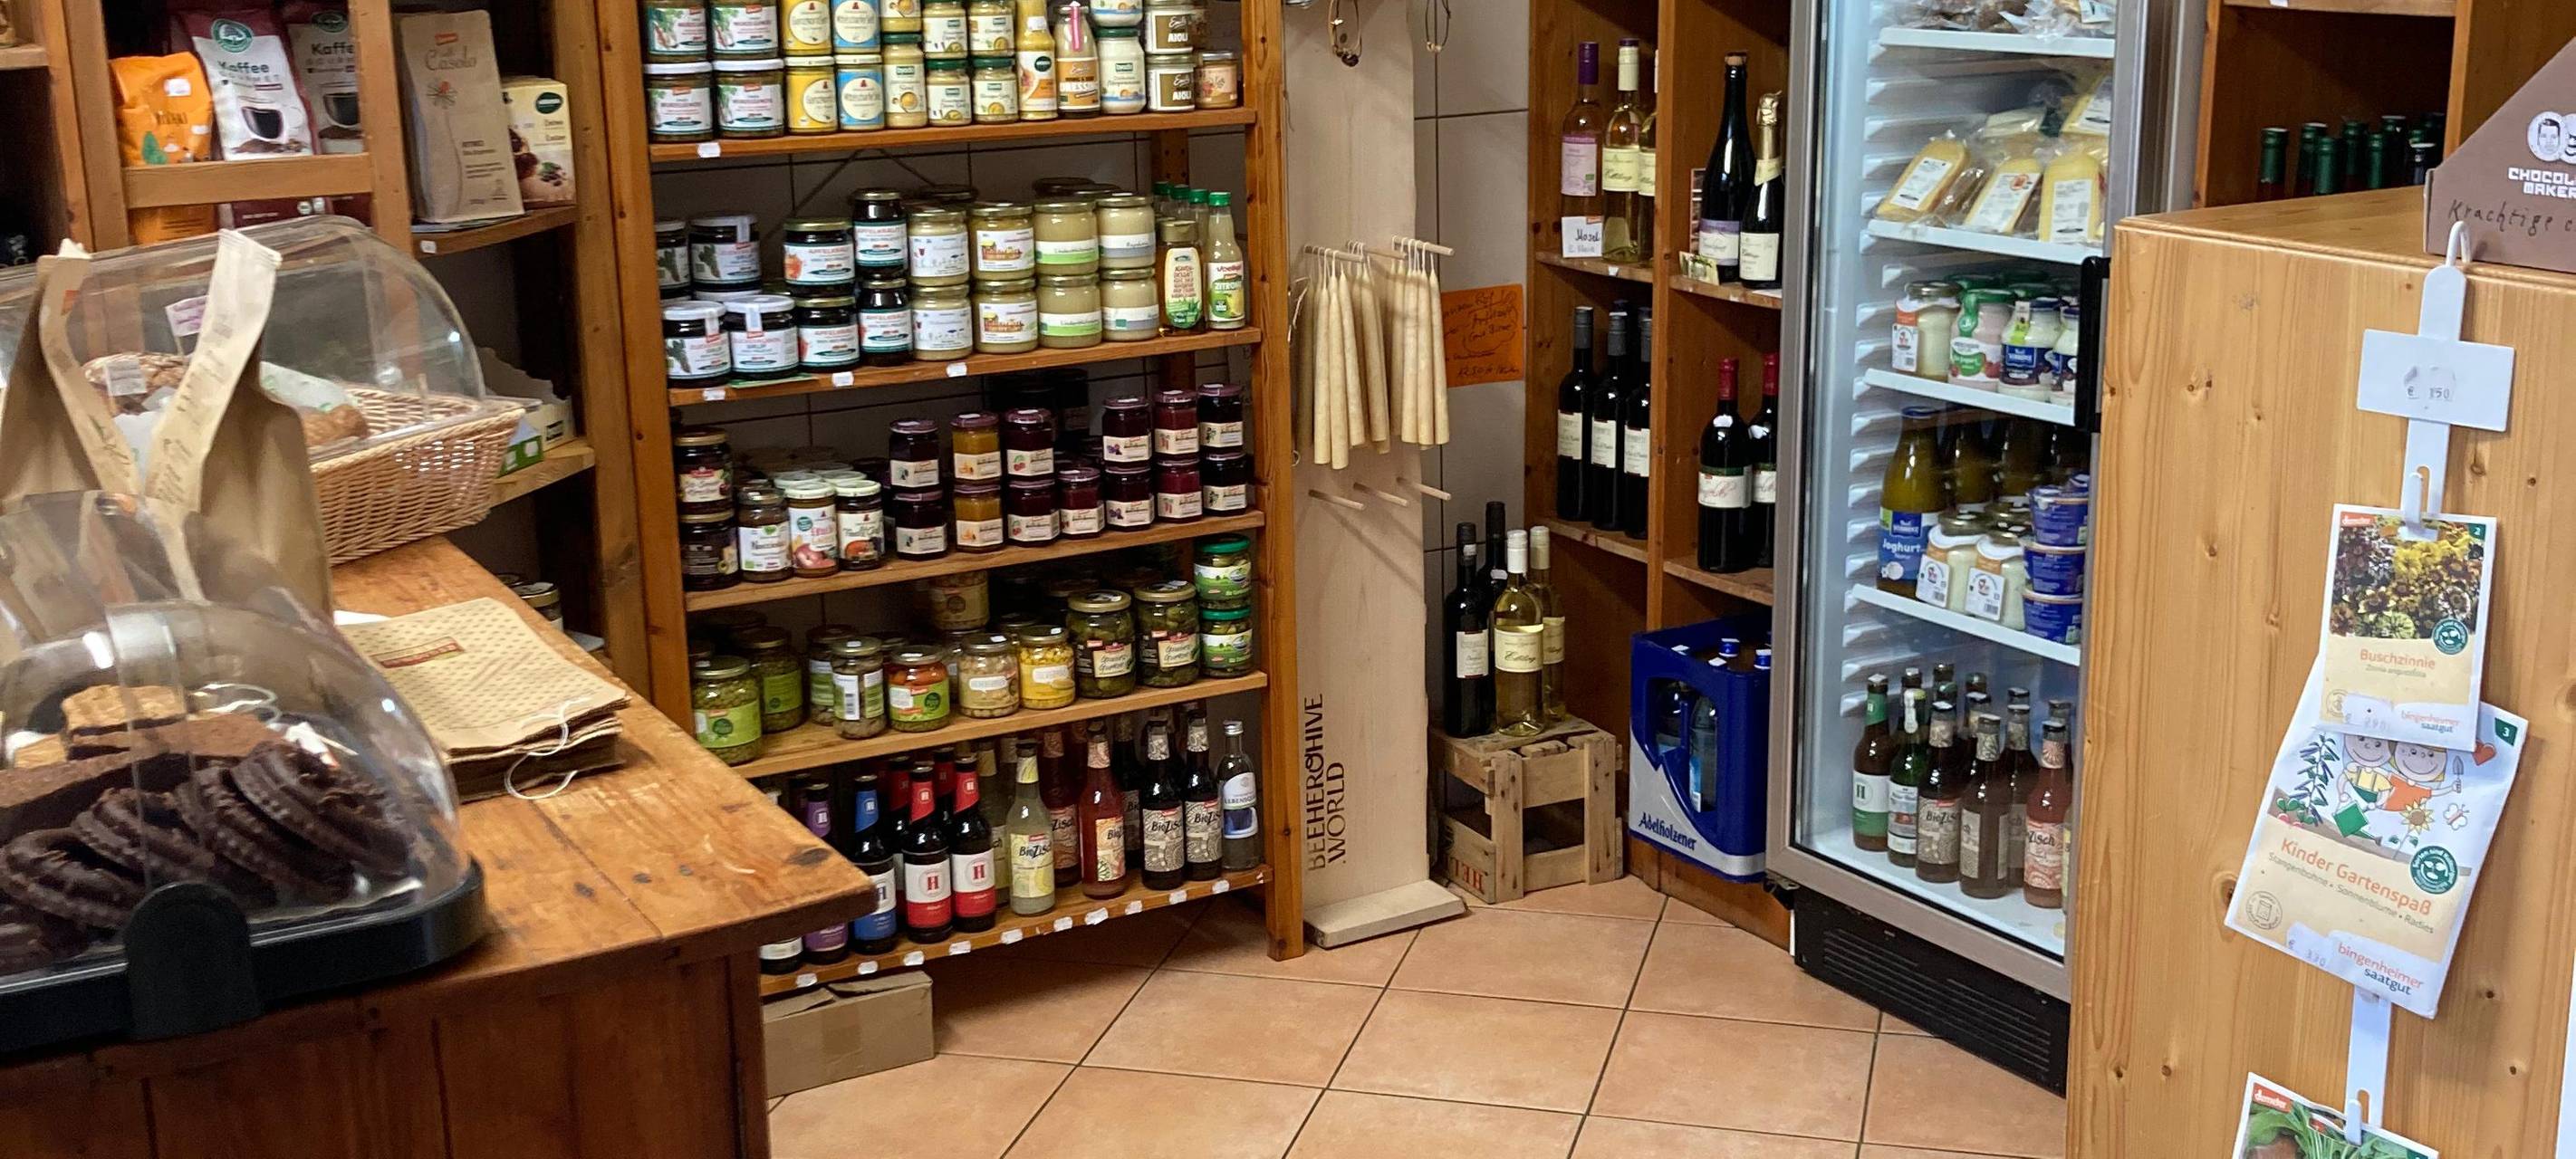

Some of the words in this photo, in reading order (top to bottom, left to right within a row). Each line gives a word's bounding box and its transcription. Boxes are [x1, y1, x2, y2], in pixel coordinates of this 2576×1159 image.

[312, 42, 355, 55] Kaffe
[2508, 167, 2576, 186] CHOCOL
[2523, 181, 2576, 199] MAKER
[2447, 199, 2553, 236] Krachtige
[2473, 526, 2481, 536] 2
[2360, 648, 2436, 670] Buschzinnie
[2502, 727, 2510, 737] 3
[1639, 811, 1697, 851] Adelholzener
[973, 865, 985, 880] H
[2282, 838, 2334, 872] Kinder
[2336, 863, 2433, 916] Gartenspaß
[928, 876, 939, 891] H
[2268, 851, 2329, 887] Stangenbohne
[2336, 883, 2398, 917] Sonnenblume
[2404, 914, 2435, 934] Radies
[2338, 941, 2425, 989] bingenheimer
[2364, 967, 2412, 995] saatgut
